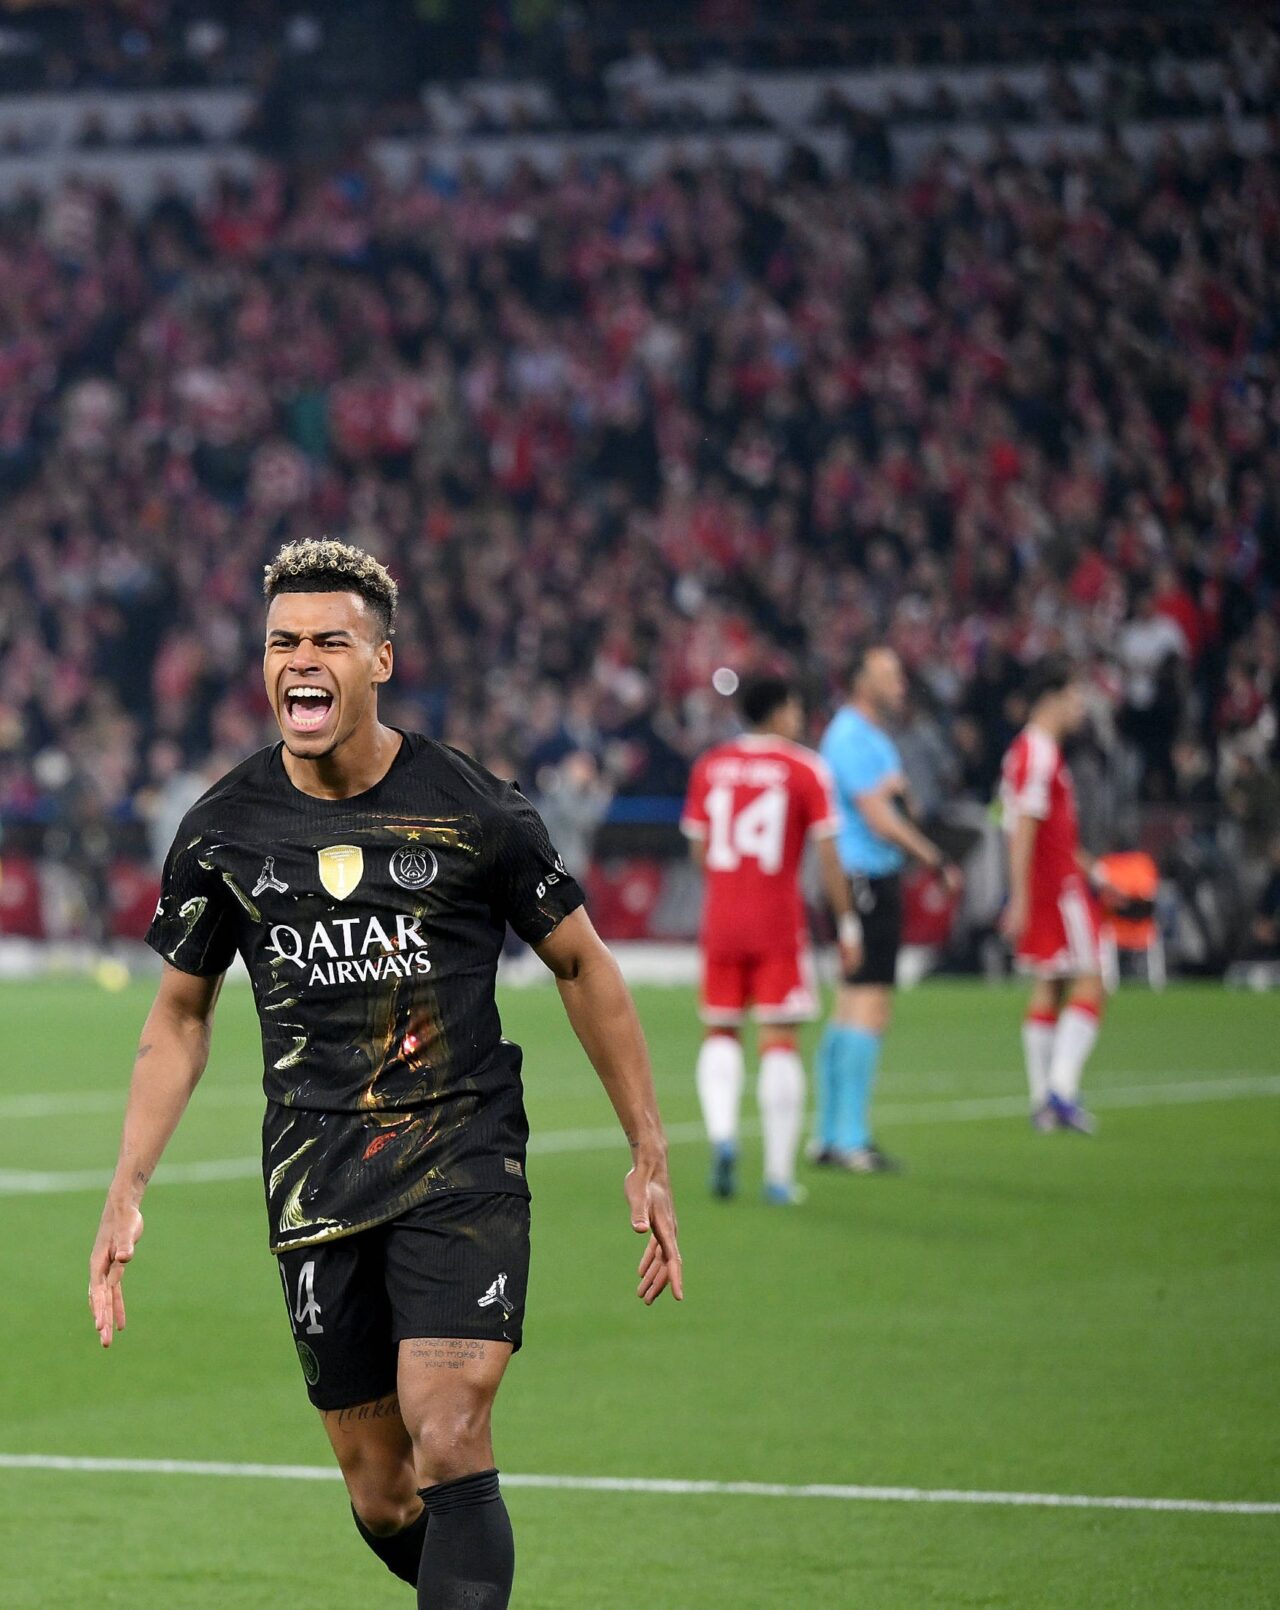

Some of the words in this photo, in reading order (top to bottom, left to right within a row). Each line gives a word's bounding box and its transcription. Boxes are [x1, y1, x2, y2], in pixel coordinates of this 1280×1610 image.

[398, 847, 427, 858] PARIS
[703, 784, 789, 875] 14
[269, 914, 428, 969] QATAR
[308, 950, 432, 987] AIRWAYS
[280, 1260, 324, 1335] 4
